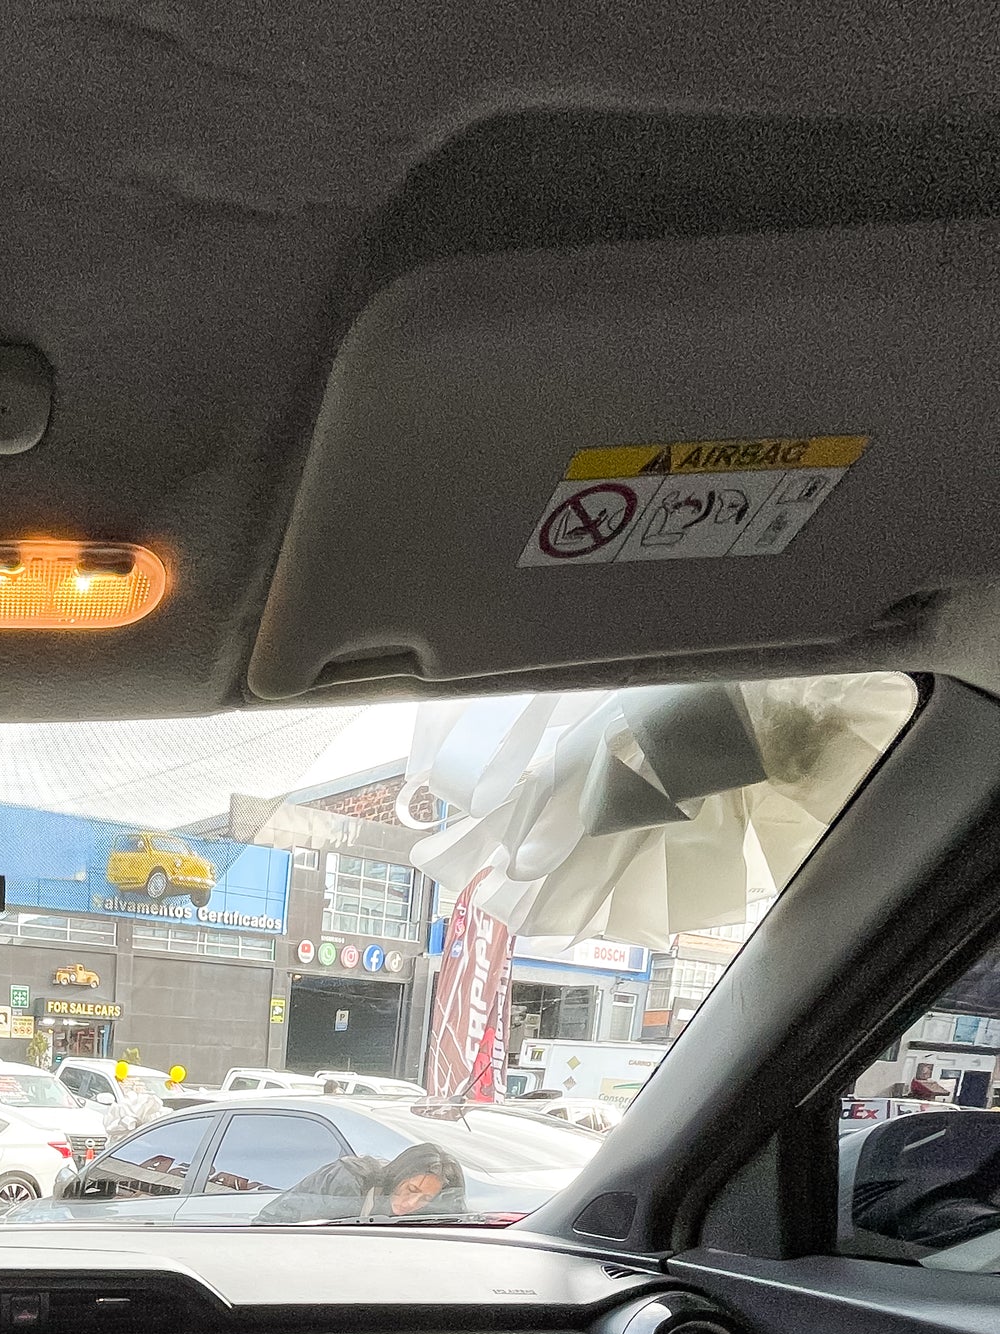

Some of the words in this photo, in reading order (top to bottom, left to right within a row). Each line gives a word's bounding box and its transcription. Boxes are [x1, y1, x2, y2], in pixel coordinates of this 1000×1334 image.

[679, 441, 810, 469] AIRBAG
[197, 906, 282, 931] Certificados
[593, 946, 626, 963] BOSCH
[47, 1001, 70, 1014] FOR
[70, 1002, 95, 1015] SALE
[95, 1004, 121, 1017] CARS
